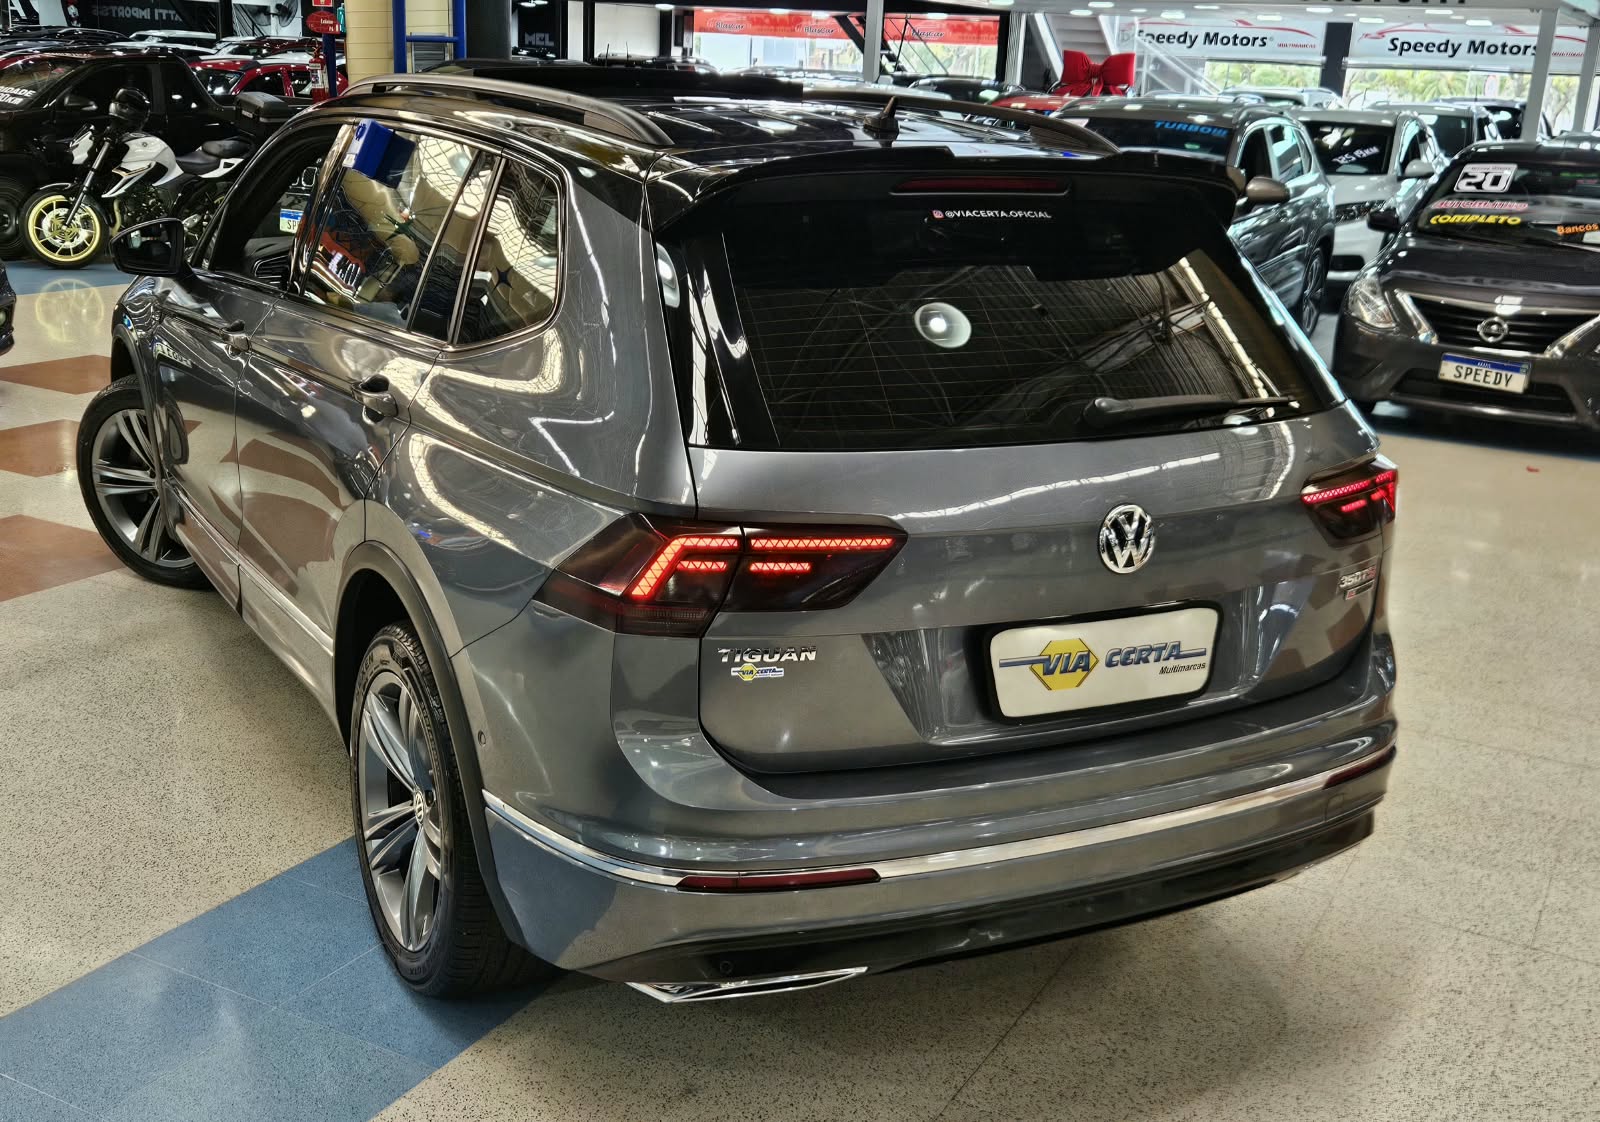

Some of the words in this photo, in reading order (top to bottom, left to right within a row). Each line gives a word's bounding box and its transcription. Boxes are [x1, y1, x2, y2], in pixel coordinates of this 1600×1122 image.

[1202, 31, 1268, 48] Motors
[1388, 37, 1462, 58] Speedy
[1457, 171, 1510, 192] 20
[944, 209, 1052, 219] @VIACERTA.OFICIAL
[1430, 214, 1521, 225] COMPLETO
[1556, 223, 1599, 235] Bancos
[1453, 364, 1513, 388] SPEEDY
[717, 646, 817, 663] TIGUAN
[1041, 649, 1091, 677] VIA
[1104, 640, 1182, 669] CERTA
[1158, 661, 1207, 676] Multimarcas
